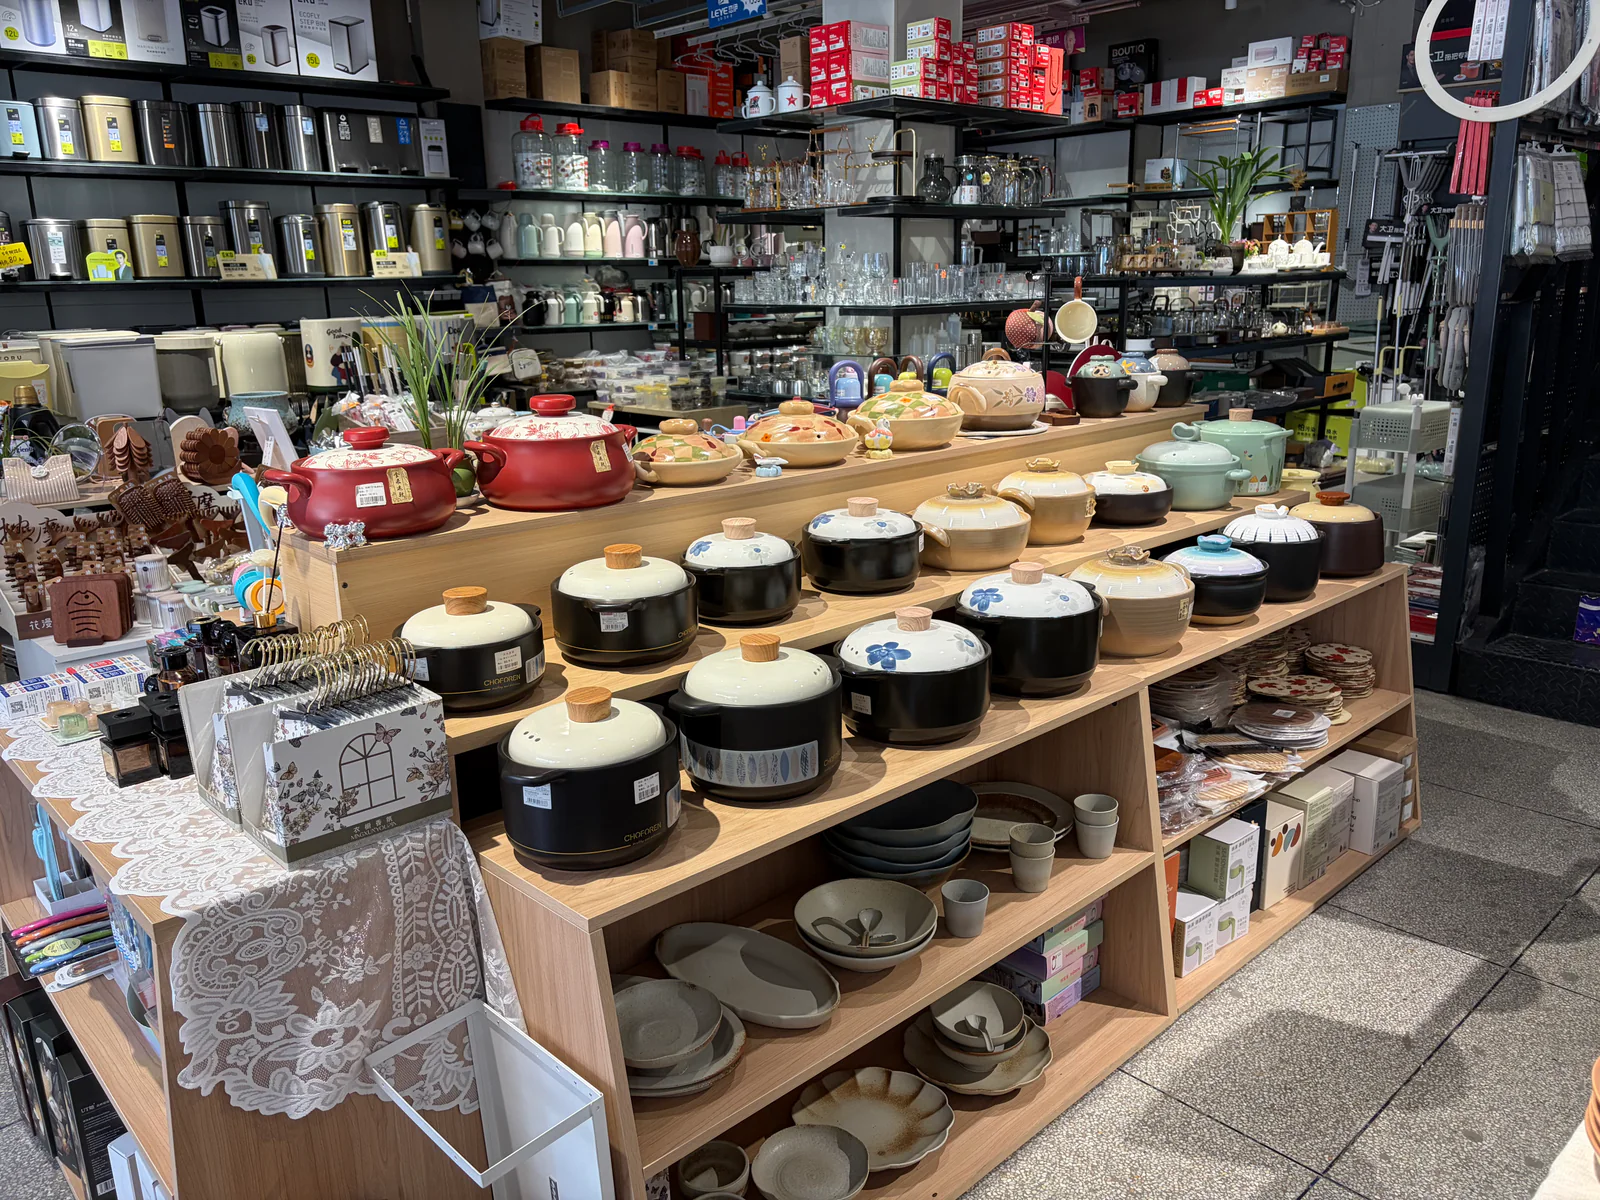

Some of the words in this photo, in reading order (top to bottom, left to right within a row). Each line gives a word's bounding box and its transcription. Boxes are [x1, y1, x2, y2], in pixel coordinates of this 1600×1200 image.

[299, 11, 320, 19] ECOFLY
[710, 6, 729, 19] LEYE
[300, 18, 316, 26] STEP
[315, 19, 327, 27] BIN
[4, 29, 19, 38] 12L
[1112, 44, 1145, 58] BOUTIQ
[246, 55, 256, 63] 8L
[306, 55, 320, 65] 15L
[326, 327, 343, 336] Good
[483, 673, 521, 688] CHOFOREN
[623, 822, 663, 843] CHOFOREN
